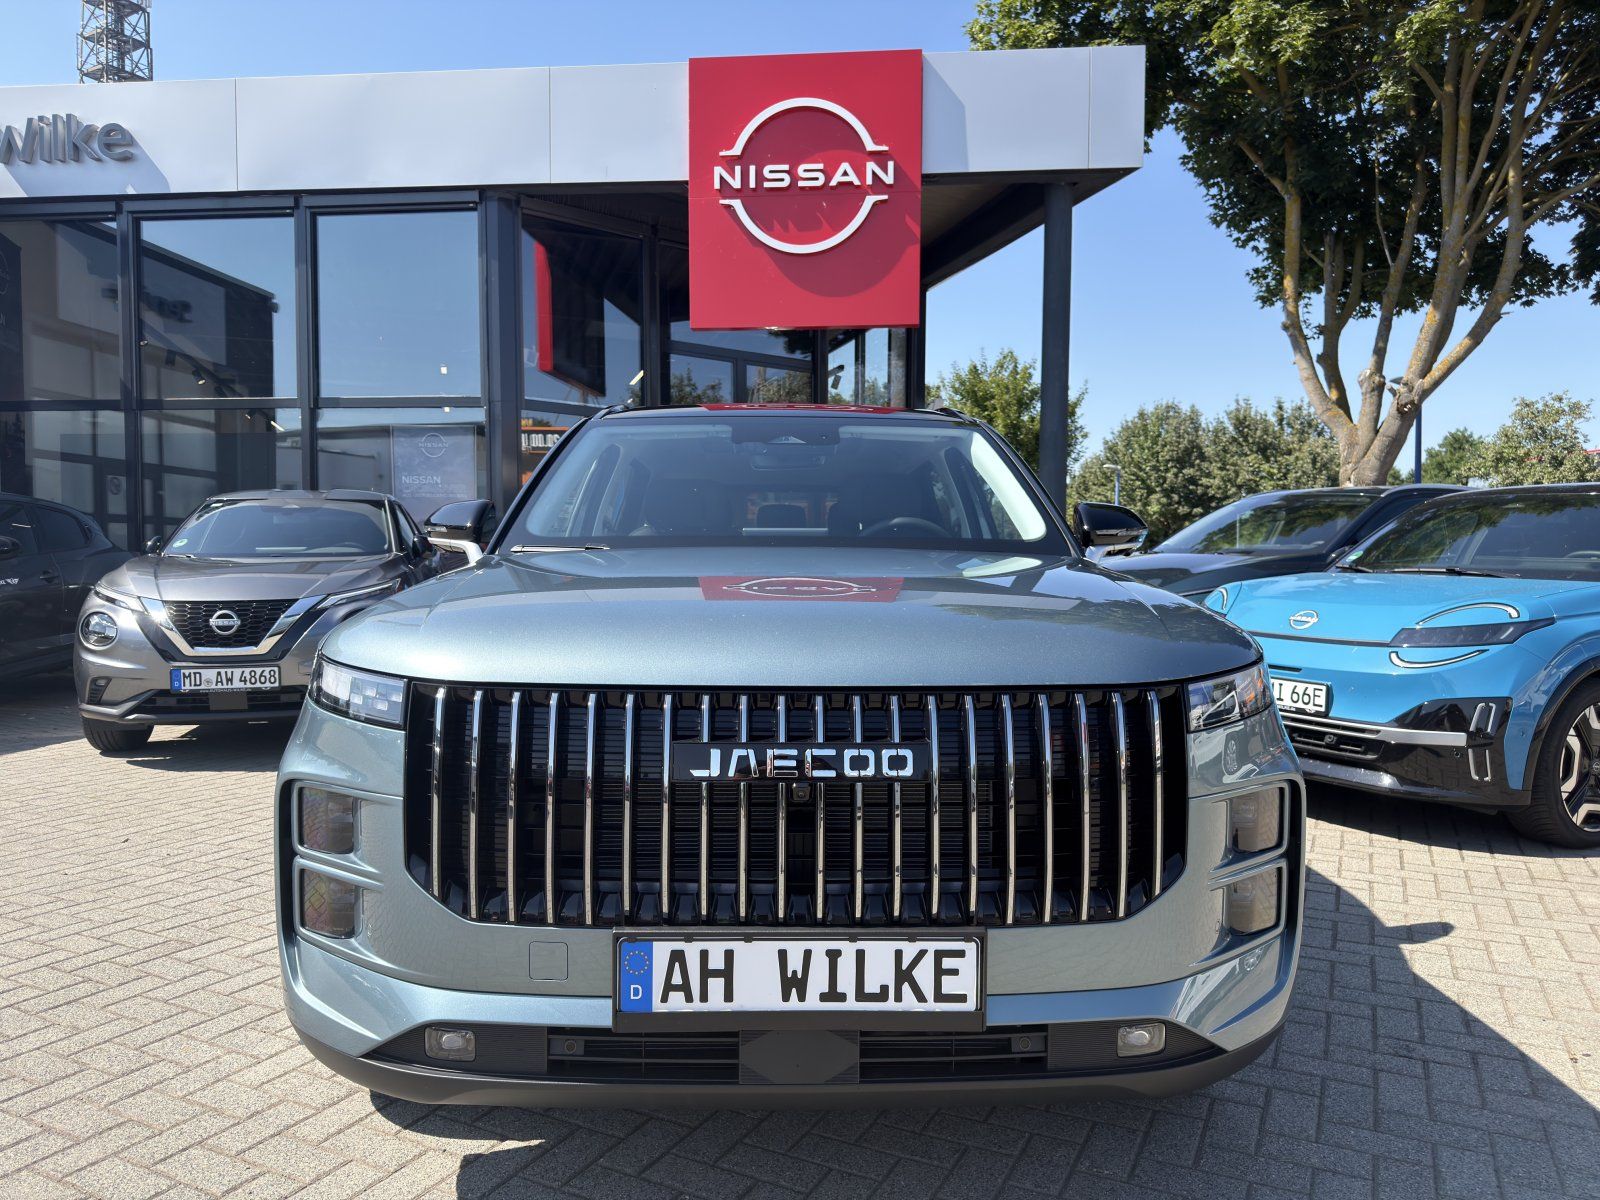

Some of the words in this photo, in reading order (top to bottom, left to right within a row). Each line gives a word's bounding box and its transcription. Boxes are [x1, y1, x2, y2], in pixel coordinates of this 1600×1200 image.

[713, 160, 895, 190] NISSAN
[401, 475, 441, 484] NISSAN
[209, 618, 241, 626] NISSAN
[182, 671, 202, 687] MD
[215, 670, 234, 686] AW
[239, 669, 278, 686] 4868
[1272, 682, 1285, 702] I
[1290, 684, 1324, 708] 66E
[689, 748, 914, 778] JAECOO
[629, 984, 643, 1000] D
[659, 948, 735, 1004] AH
[777, 948, 968, 1004] WILKE
